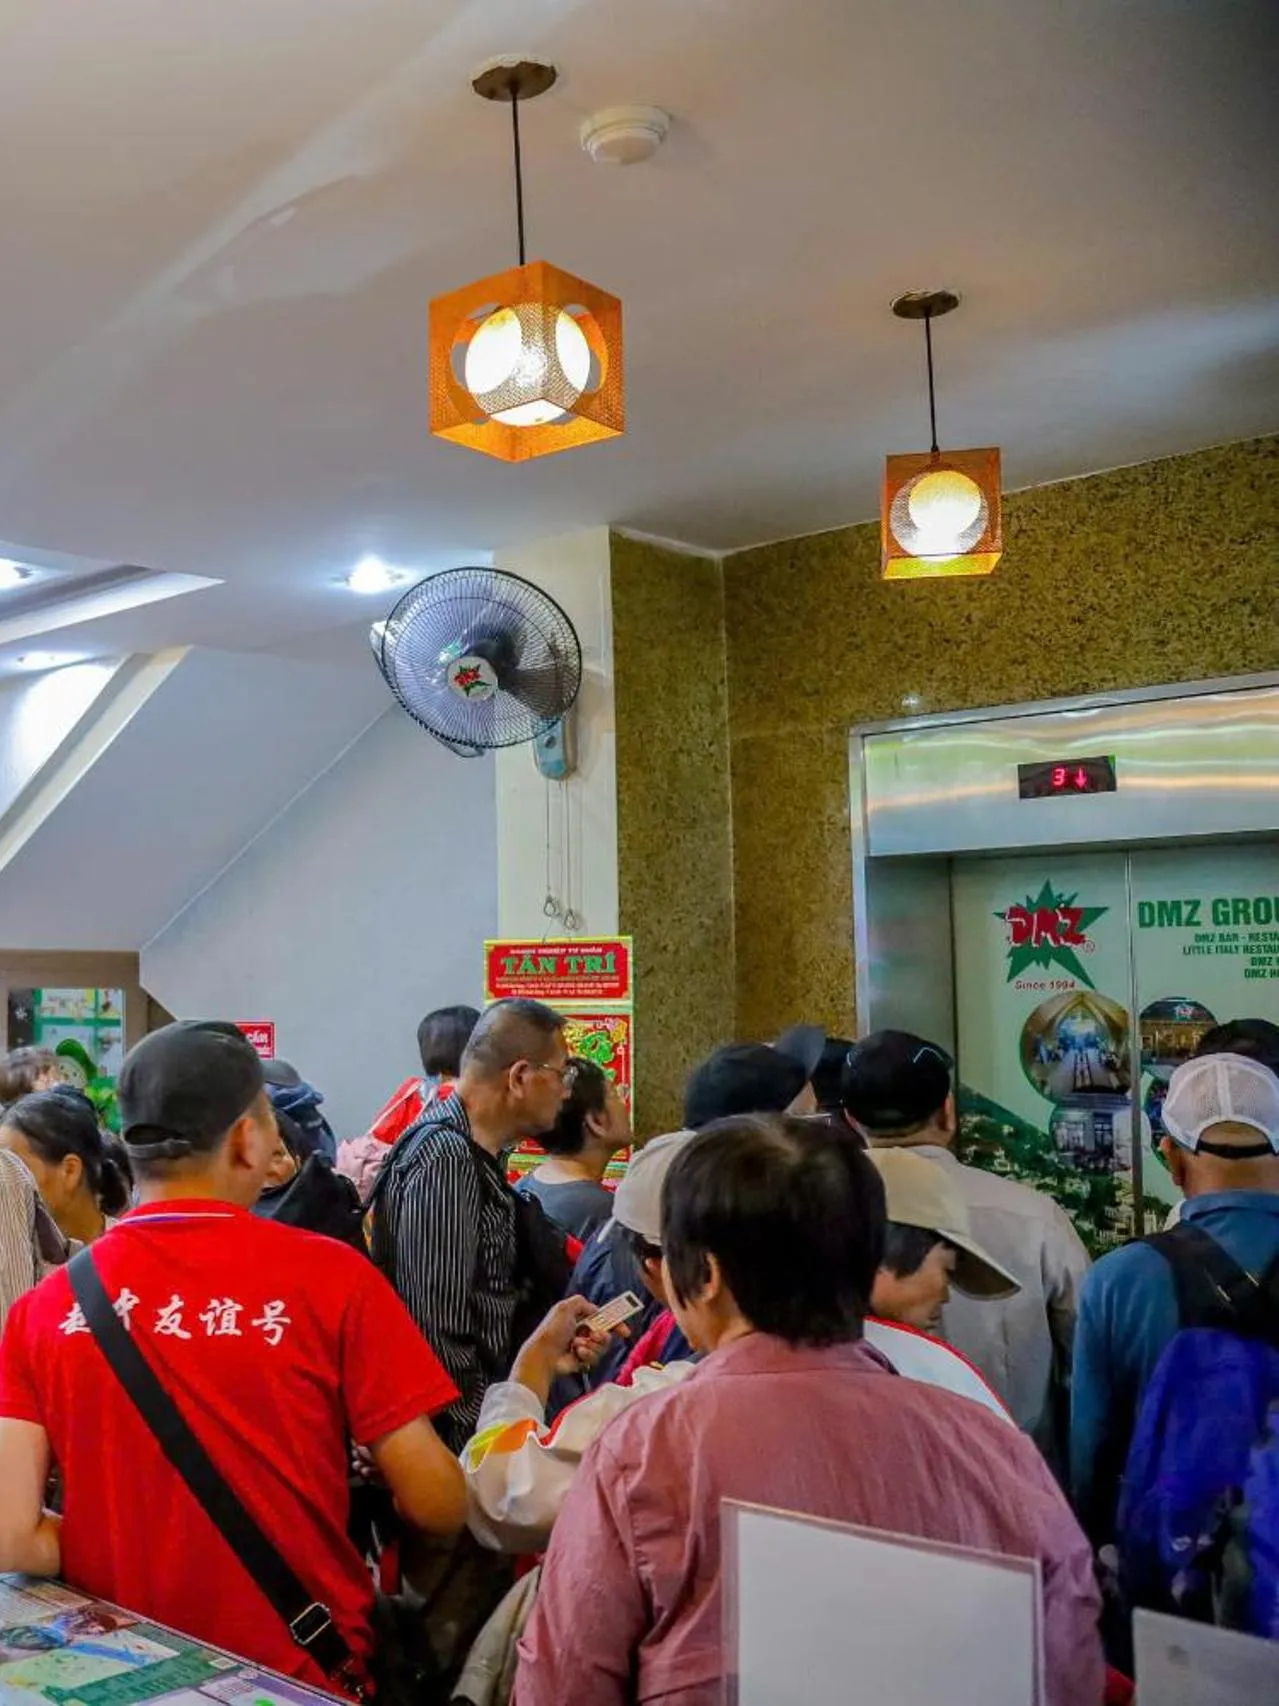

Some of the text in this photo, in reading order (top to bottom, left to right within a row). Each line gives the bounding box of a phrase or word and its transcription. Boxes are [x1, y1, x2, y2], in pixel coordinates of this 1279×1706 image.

[1052, 767, 1065, 786] 3
[1138, 896, 1279, 928] DMZ GRO
[1004, 905, 1087, 948] DMZ
[1015, 980, 1046, 990] Since
